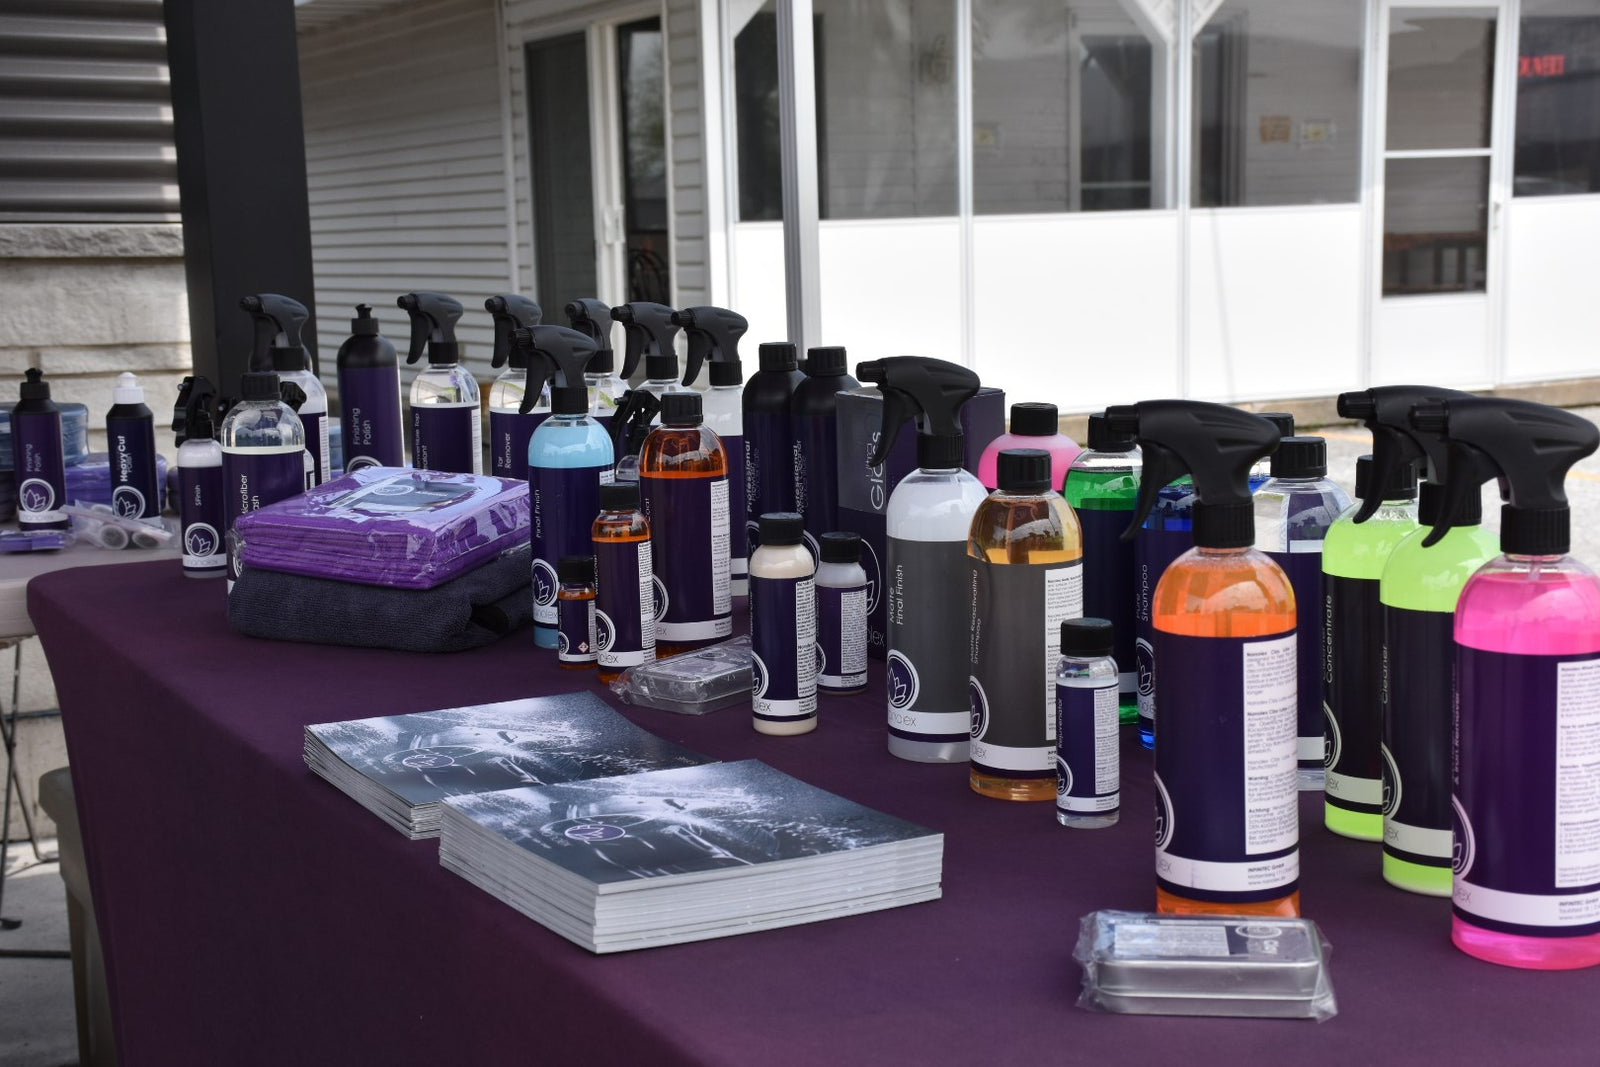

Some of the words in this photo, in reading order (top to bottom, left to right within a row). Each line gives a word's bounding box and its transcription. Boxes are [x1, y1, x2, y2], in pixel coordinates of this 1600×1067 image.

[351, 408, 361, 445] Finishing
[362, 420, 371, 446] Polish
[240, 474, 249, 514] icrofiber
[251, 495, 260, 511] ash
[895, 565, 903, 595] Finish
[1141, 565, 1149, 622] Shampoo
[896, 598, 904, 625] Final
